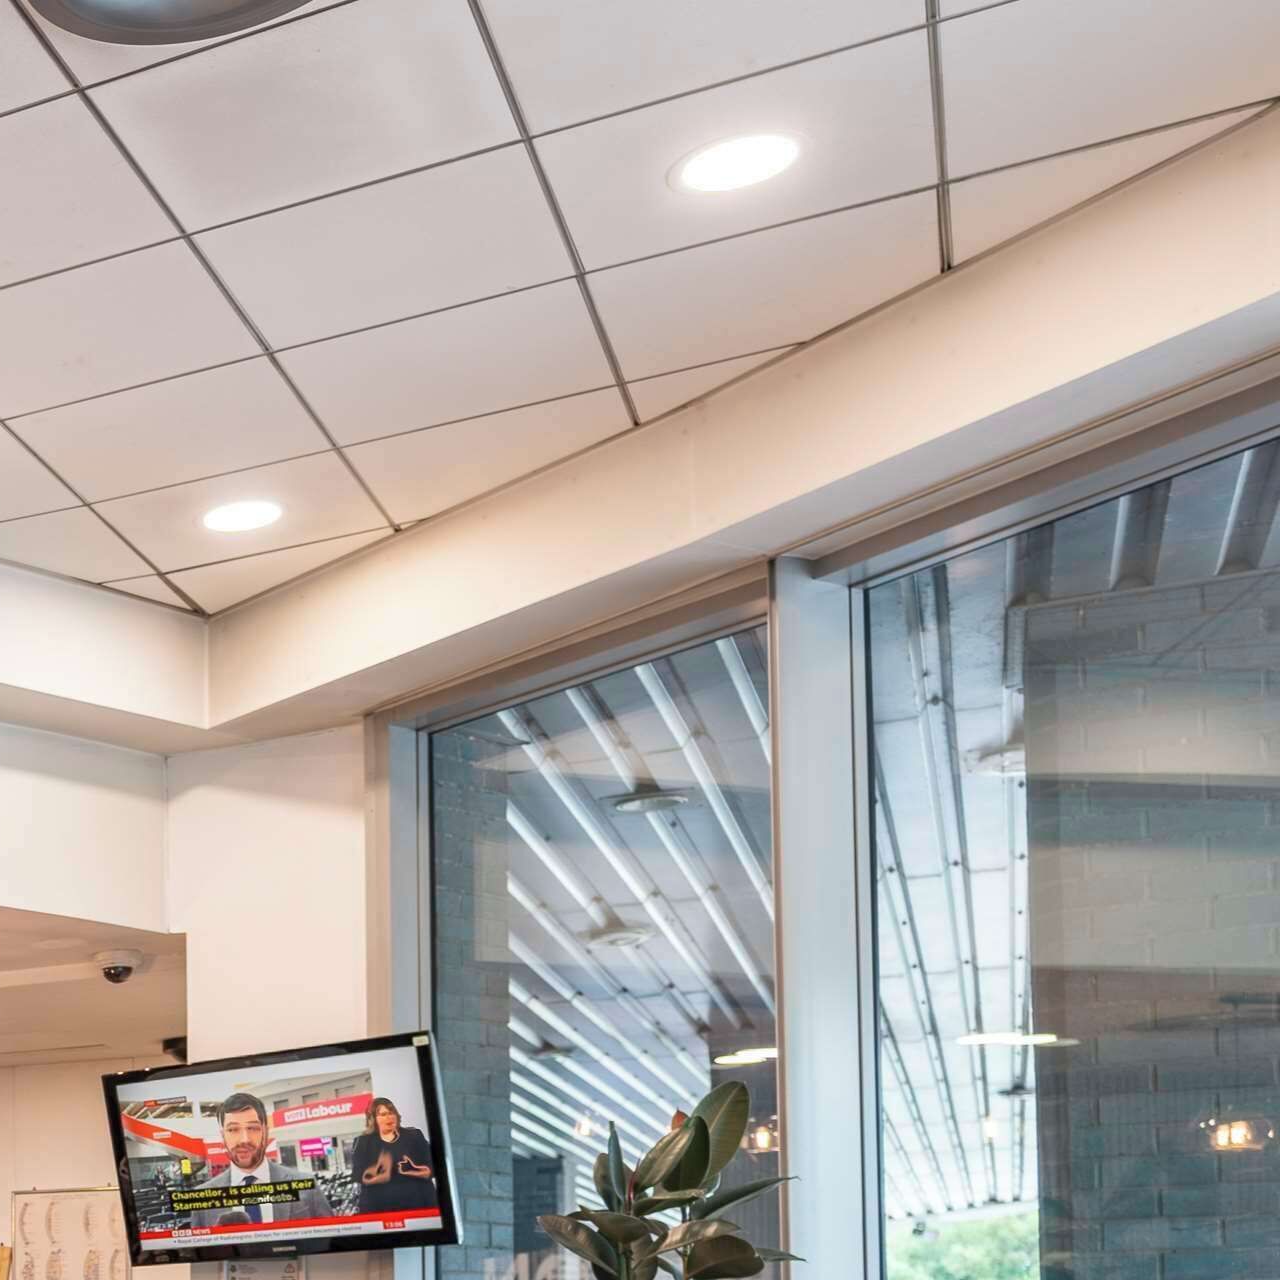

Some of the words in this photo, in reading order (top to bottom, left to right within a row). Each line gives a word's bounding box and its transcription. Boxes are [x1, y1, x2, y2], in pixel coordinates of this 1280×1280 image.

[307, 1103, 352, 1118] Labour
[229, 1187, 238, 1195] is
[240, 1183, 274, 1195] calling
[276, 1183, 289, 1191] us
[291, 1180, 313, 1189] Keir
[173, 1199, 220, 1211] Starmer's
[223, 1197, 240, 1206] tax
